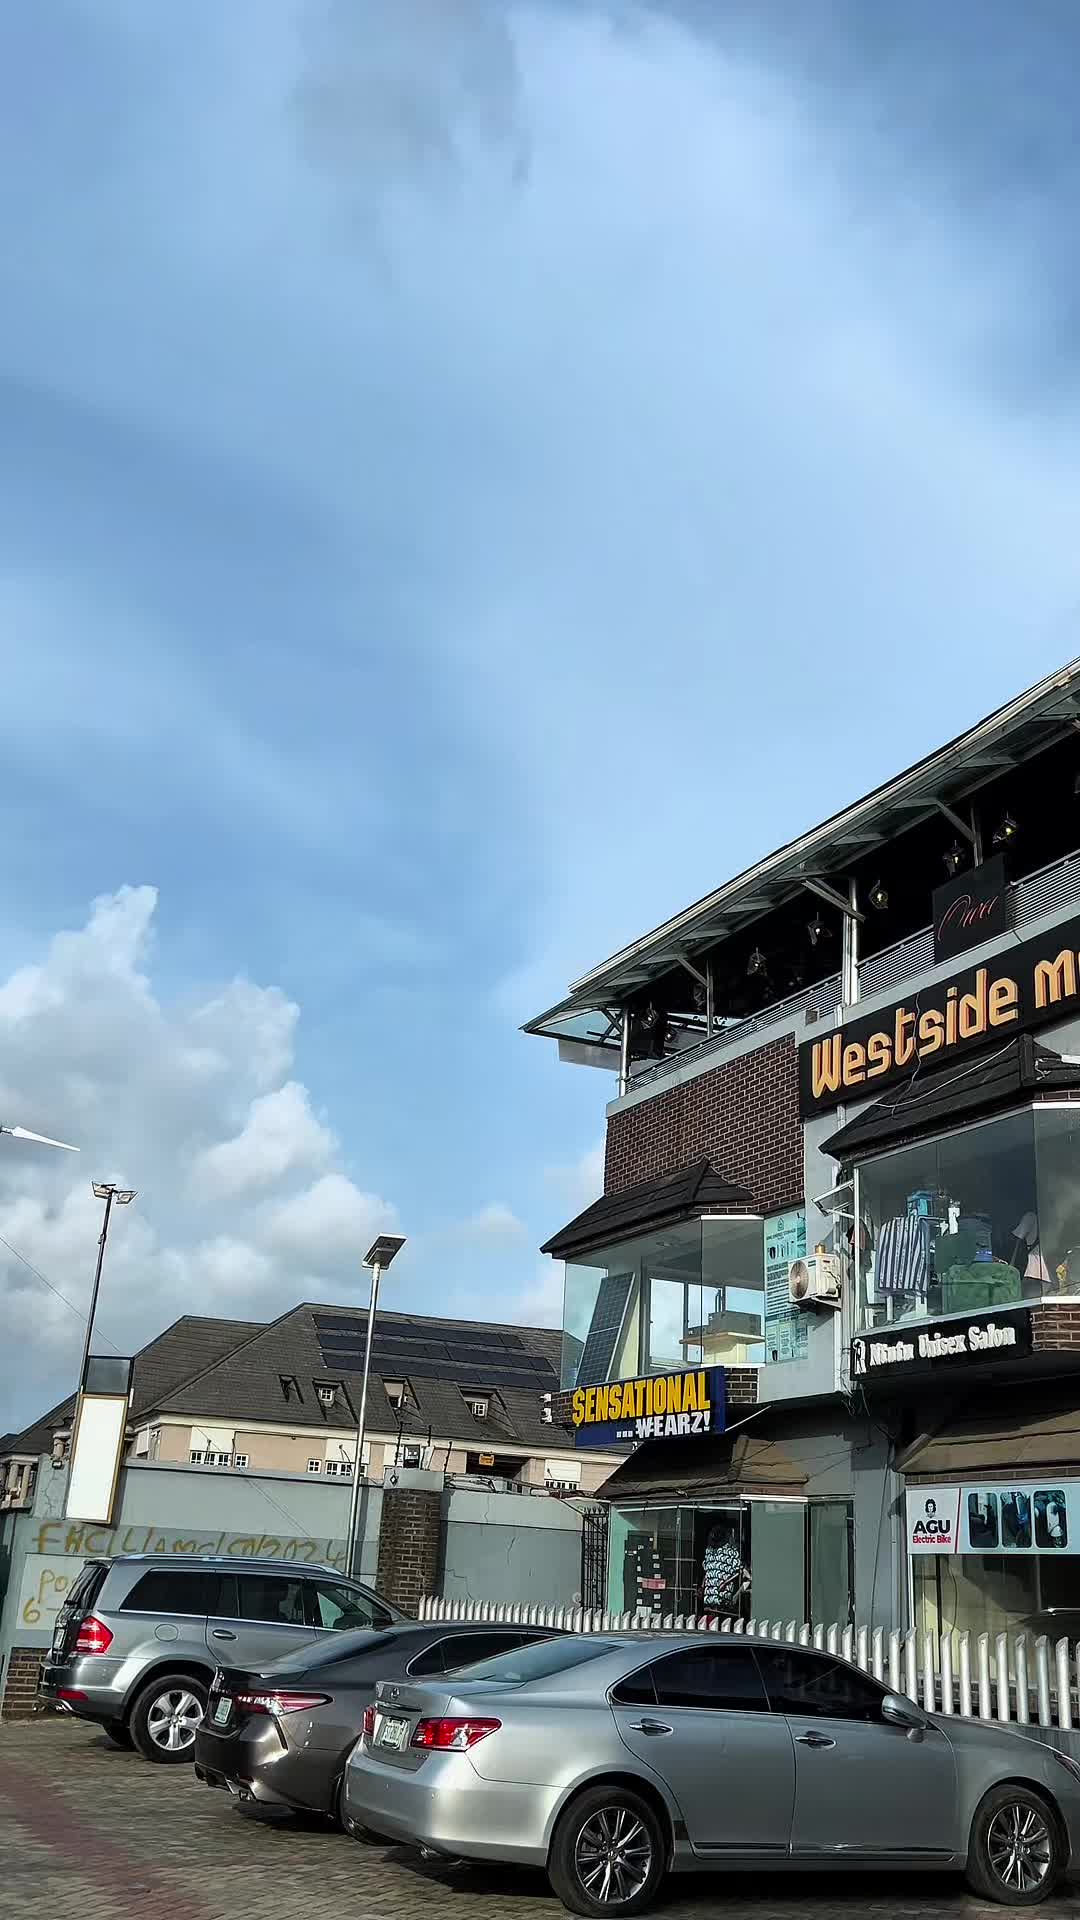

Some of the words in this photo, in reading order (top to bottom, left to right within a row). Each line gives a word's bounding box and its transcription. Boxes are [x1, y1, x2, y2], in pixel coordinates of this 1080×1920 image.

[812, 969, 1018, 1098] Westside
[918, 1333, 967, 1358] Unisex
[968, 1324, 1016, 1350] Salon
[912, 1534, 936, 1544] Electric
[936, 1534, 952, 1544] Bike
[913, 1520, 950, 1534] AGU
